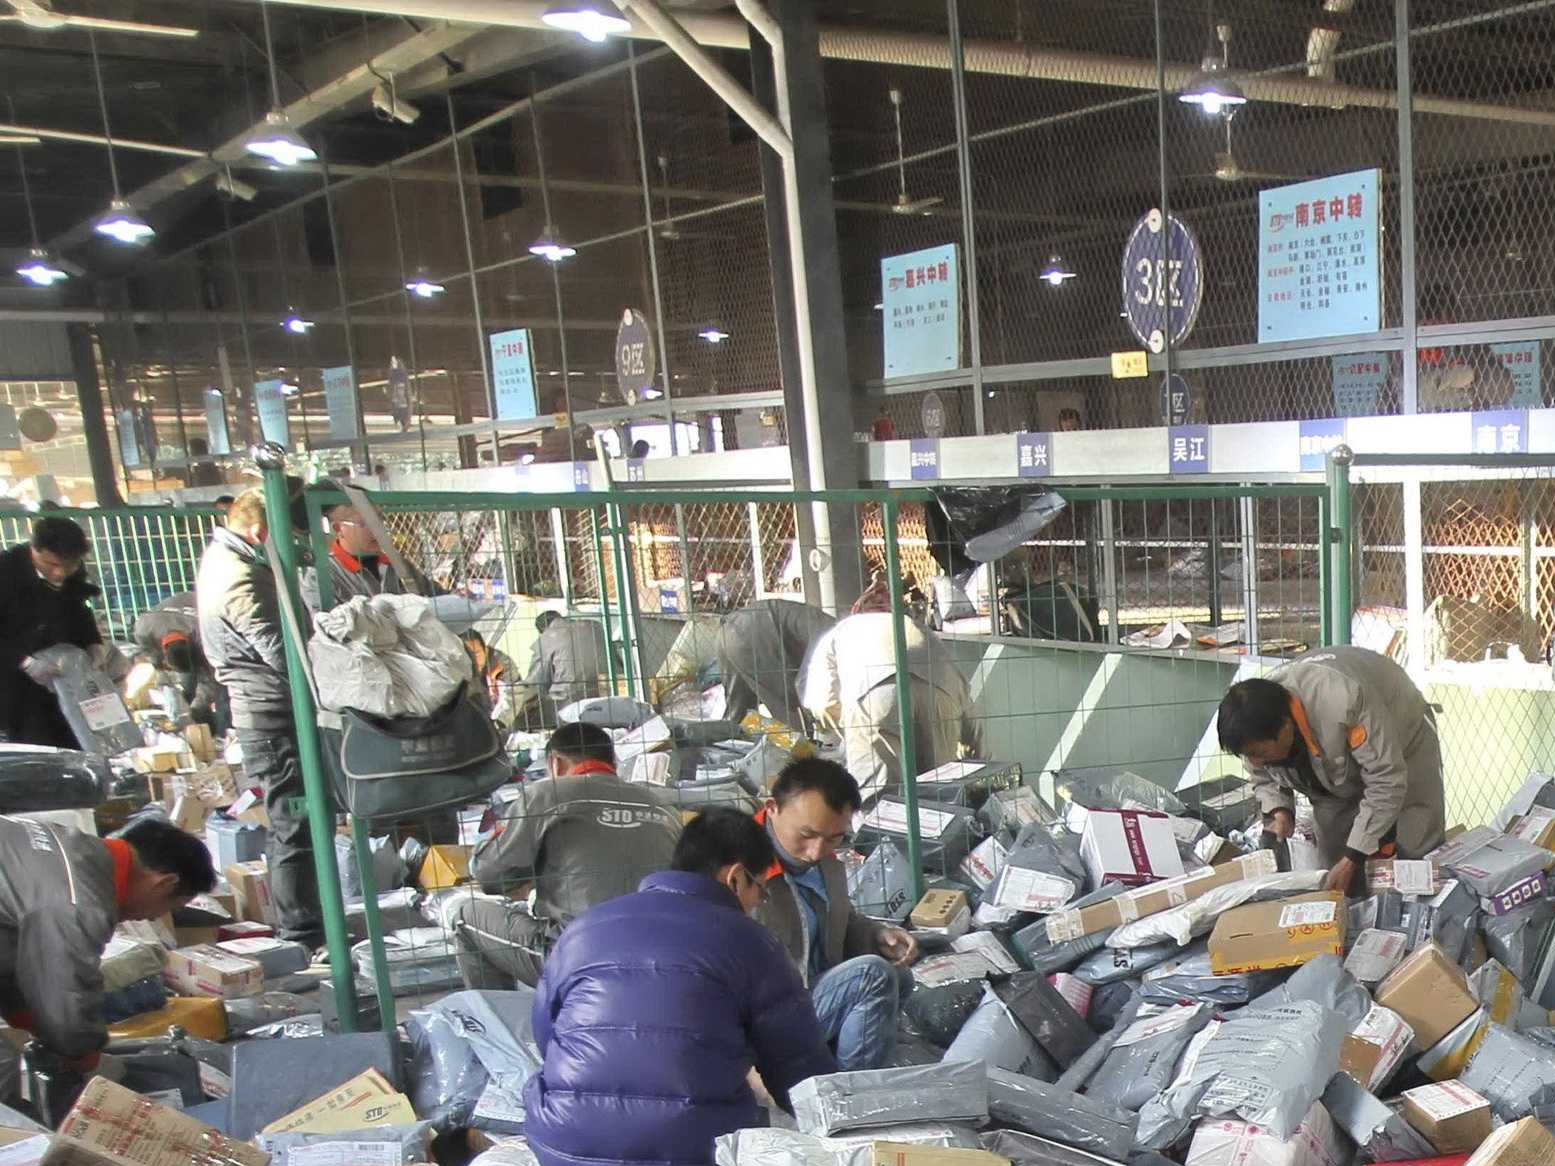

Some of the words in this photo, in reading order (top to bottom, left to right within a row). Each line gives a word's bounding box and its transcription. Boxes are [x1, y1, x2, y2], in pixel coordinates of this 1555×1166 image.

[1296, 192, 1362, 228] 南京中转
[1135, 257, 1184, 307] 3区
[1020, 444, 1047, 467] 嘉兴
[1173, 438, 1205, 462] 吴江
[602, 808, 633, 823] STO
[366, 1106, 383, 1120] STO
